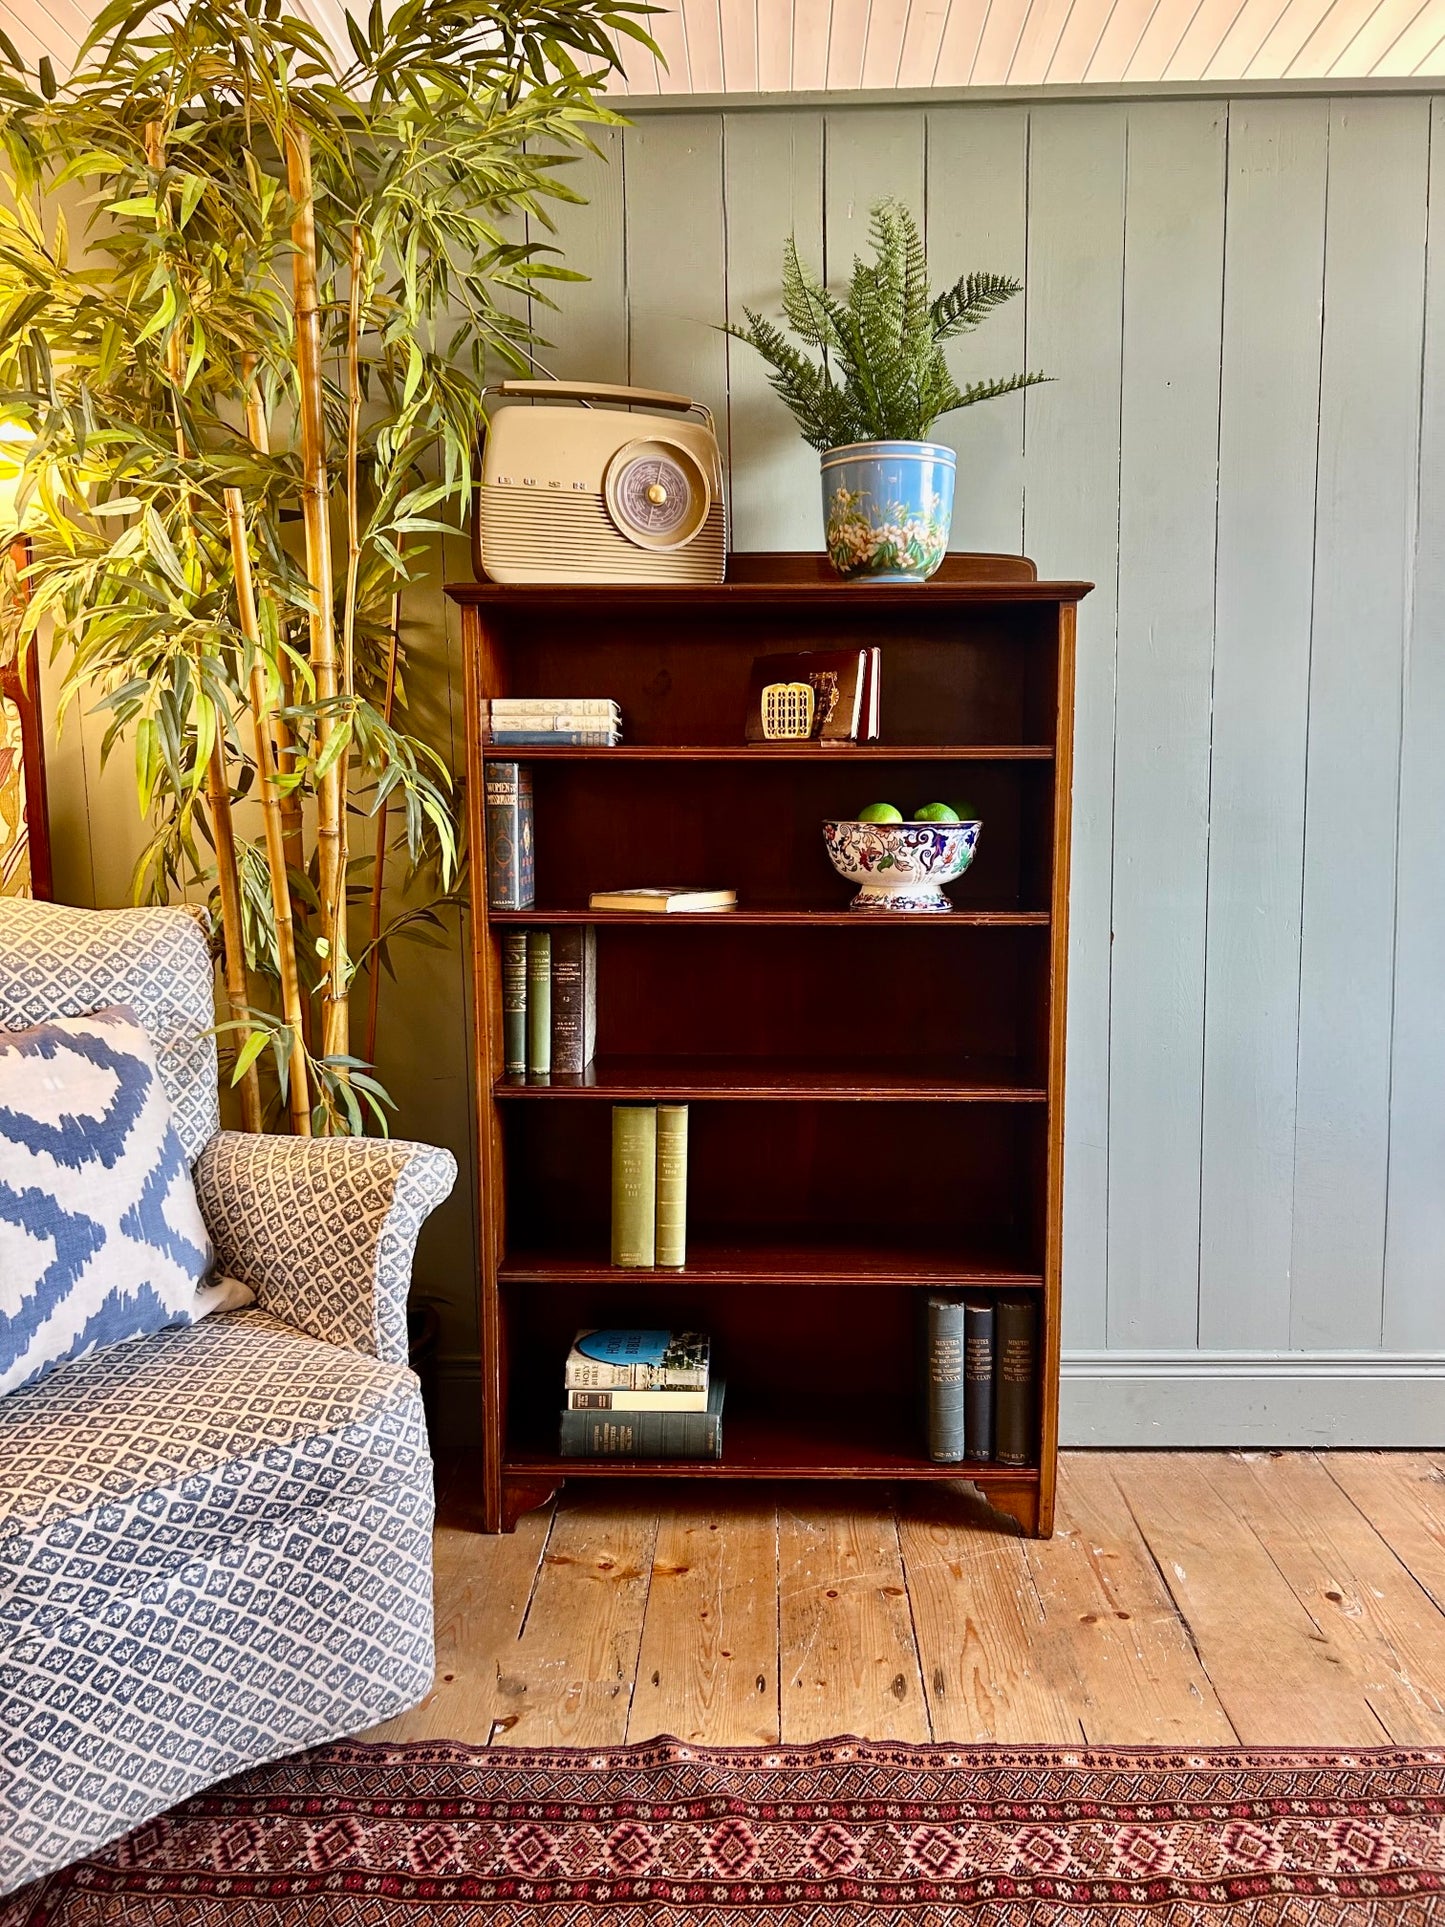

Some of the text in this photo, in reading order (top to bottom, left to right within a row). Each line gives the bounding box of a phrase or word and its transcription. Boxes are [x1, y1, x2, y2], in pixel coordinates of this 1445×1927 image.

[605, 1336, 622, 1354] HOLY
[625, 1336, 642, 1355] BIBLE
[583, 1364, 591, 1386] HOLY
